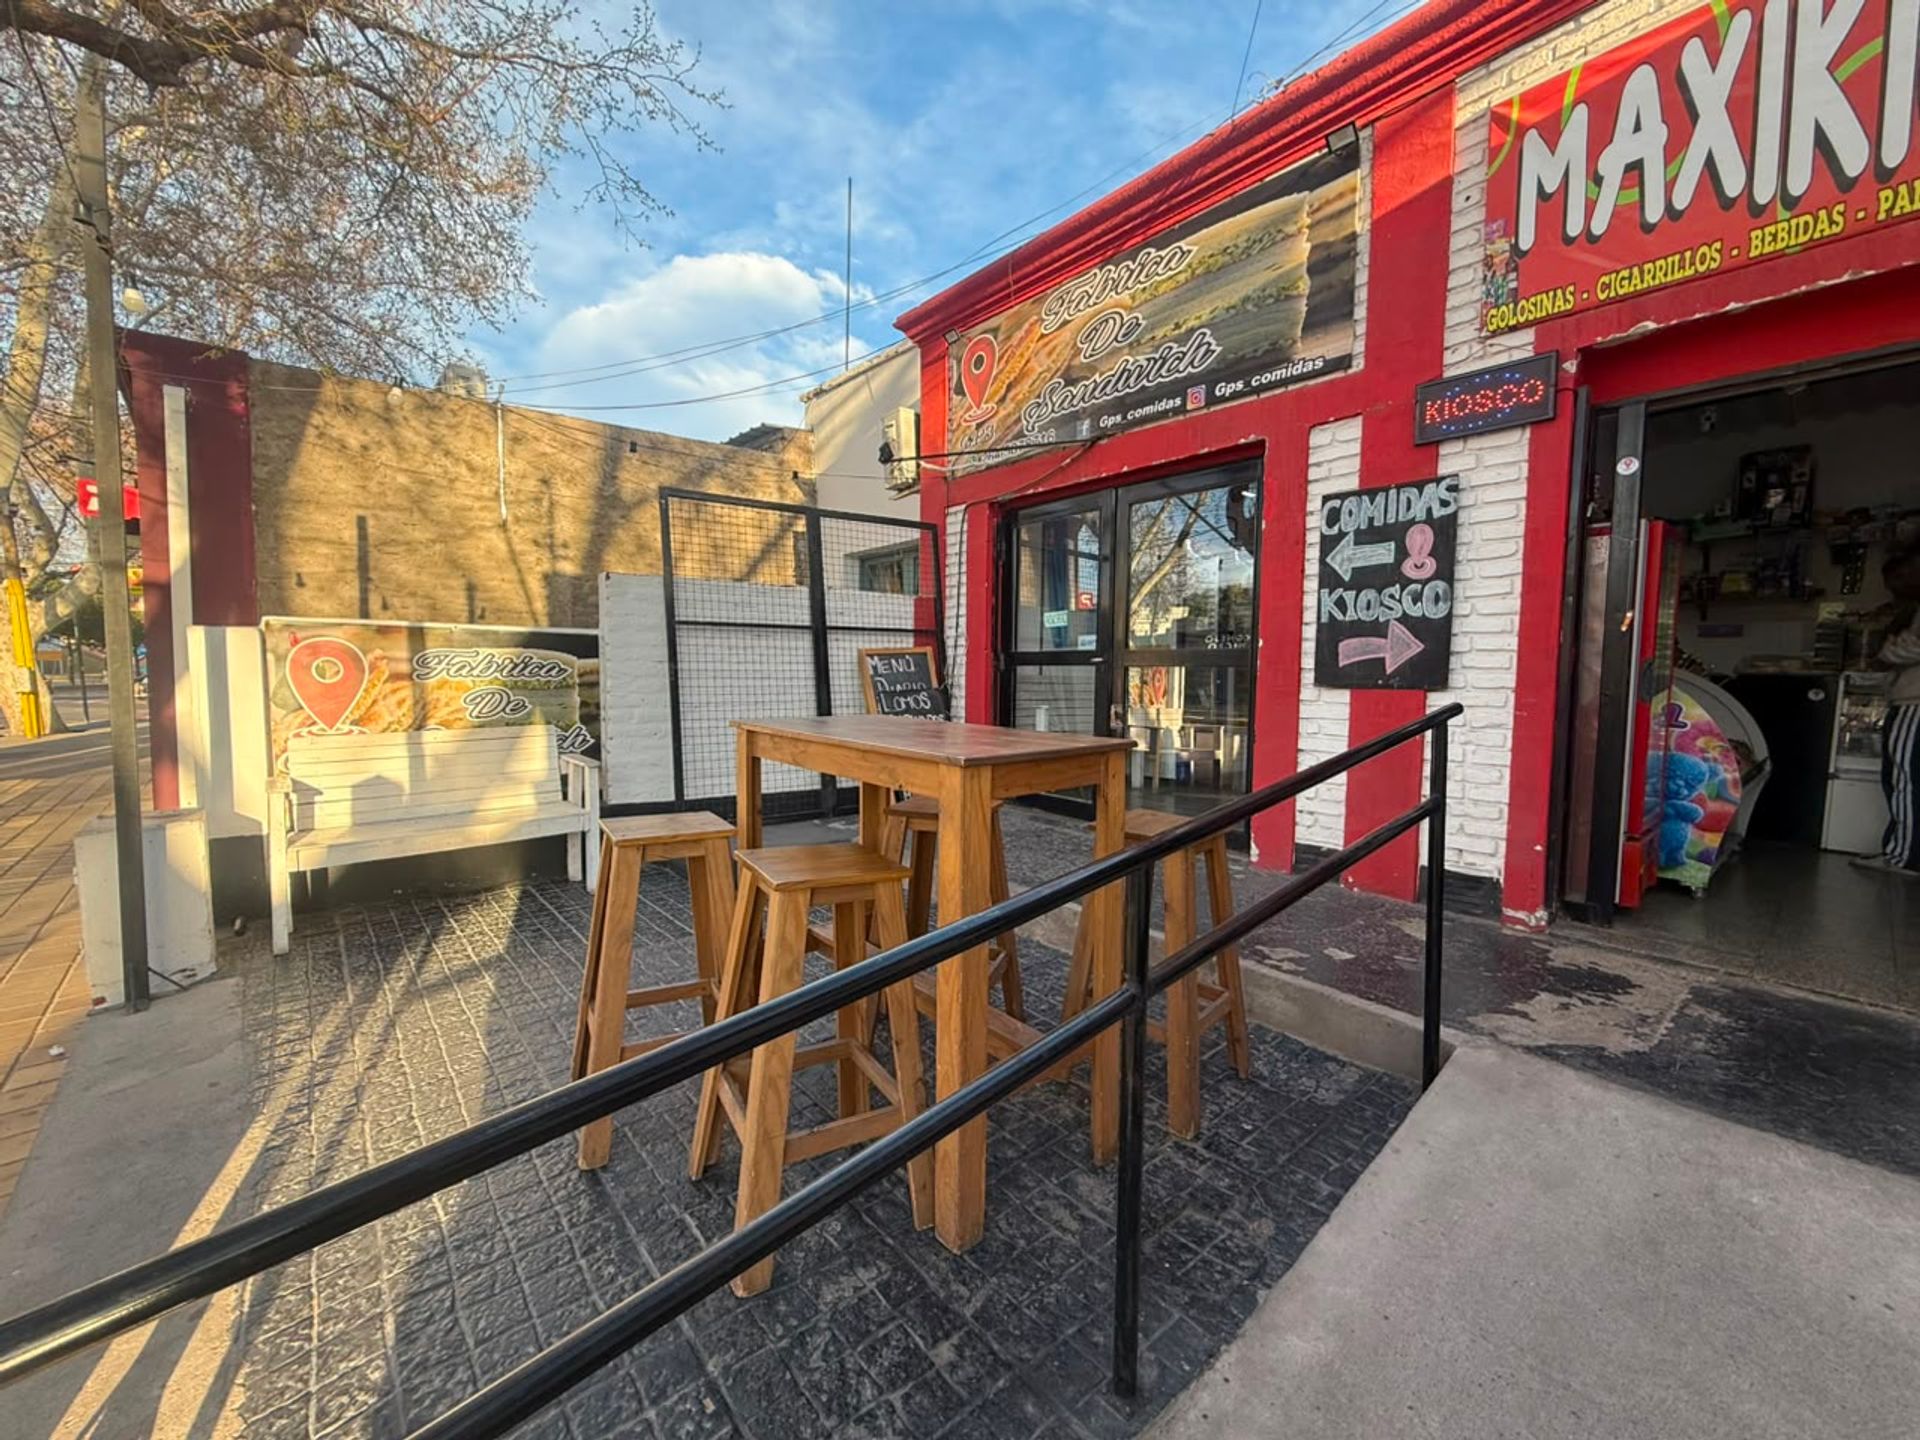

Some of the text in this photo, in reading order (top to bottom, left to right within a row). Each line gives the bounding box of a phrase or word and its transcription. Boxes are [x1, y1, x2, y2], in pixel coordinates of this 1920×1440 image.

[1040, 242, 1198, 335] Fabrica
[1486, 284, 1576, 333] GOLOSINAS
[1596, 240, 1724, 301] CIGARRILLOS
[1749, 202, 1846, 258] BEBIDAS
[1077, 307, 1145, 362] De
[1021, 328, 1222, 435] Sandwich
[1214, 356, 1325, 398] Gps_comidas
[1099, 395, 1182, 428] Gps_comidas
[1425, 379, 1544, 424] KIOSCO
[1321, 476, 1459, 535] COMIDAS
[1320, 580, 1451, 622] KIOSCO
[412, 648, 573, 682] Fabrica
[463, 687, 532, 720] De
[880, 692, 931, 713] LOMOS
